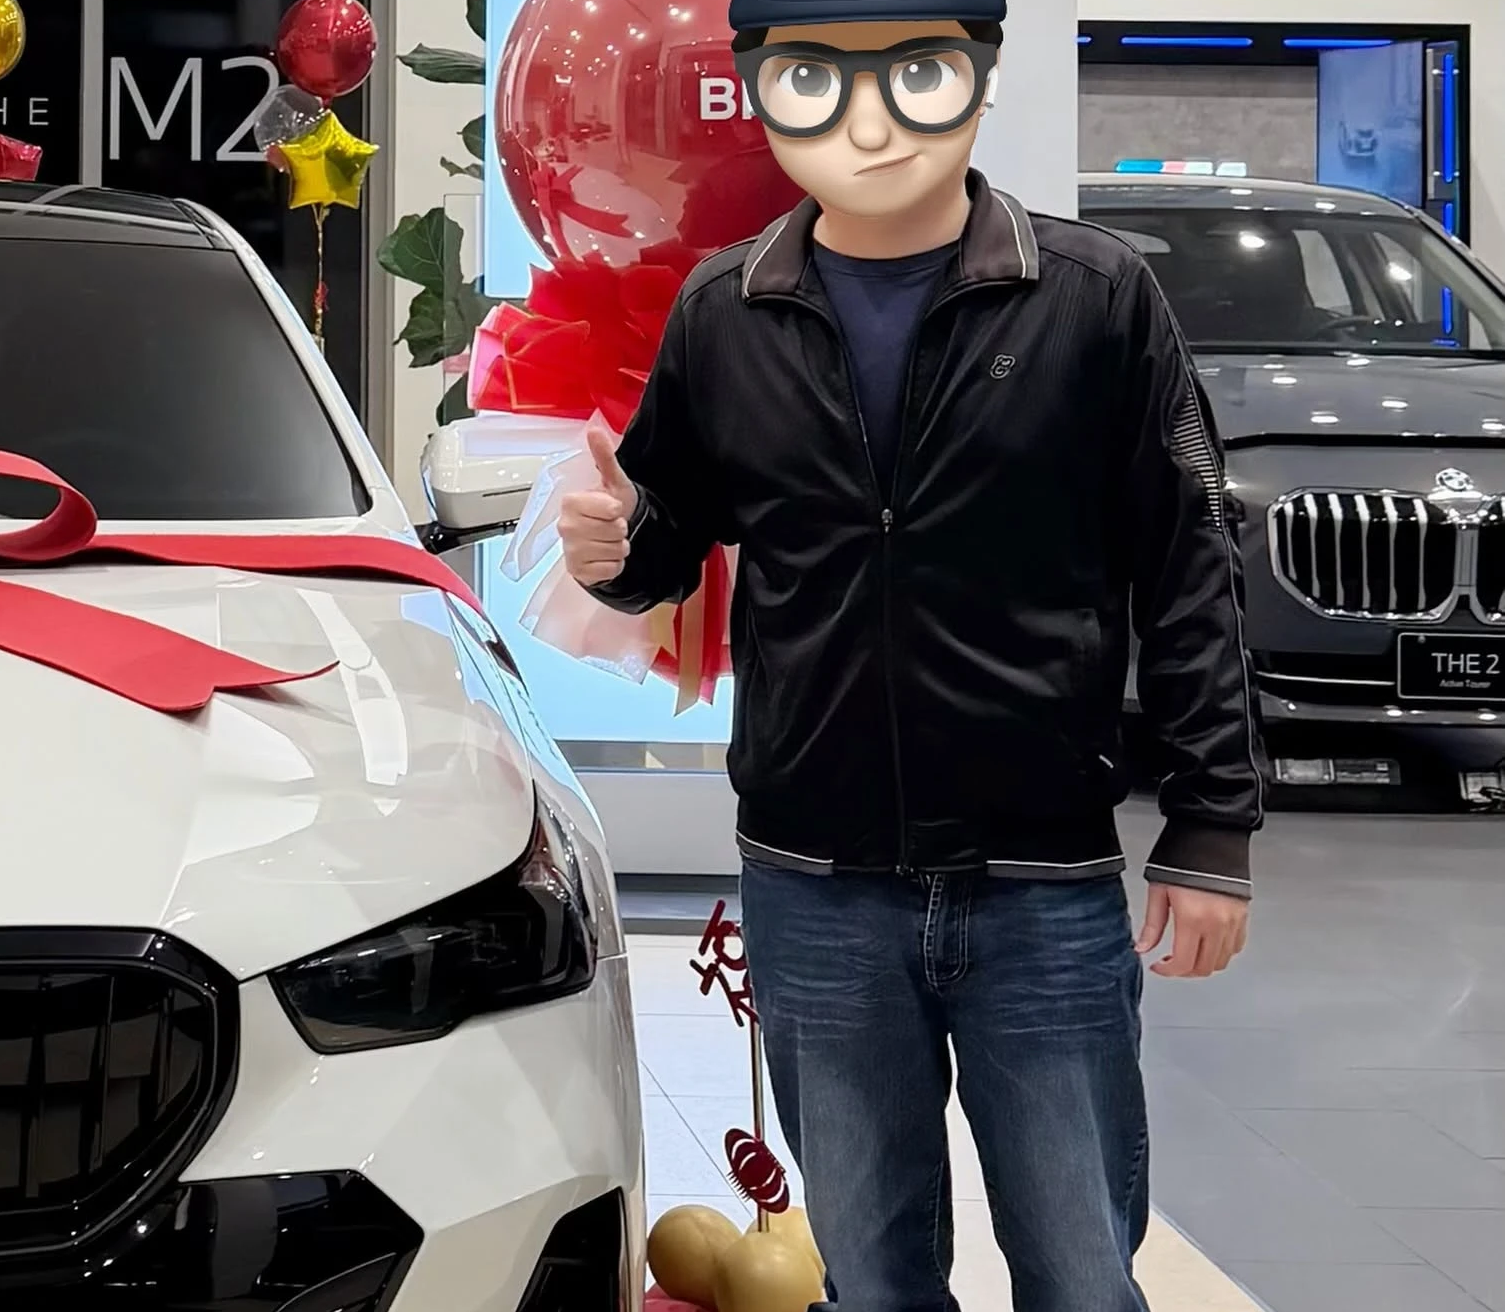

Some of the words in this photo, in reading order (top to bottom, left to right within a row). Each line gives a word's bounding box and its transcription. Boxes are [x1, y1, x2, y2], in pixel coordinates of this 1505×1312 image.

[109, 56, 279, 161] M2
[1431, 652, 1481, 674] THE
[1485, 653, 1500, 674] 2
